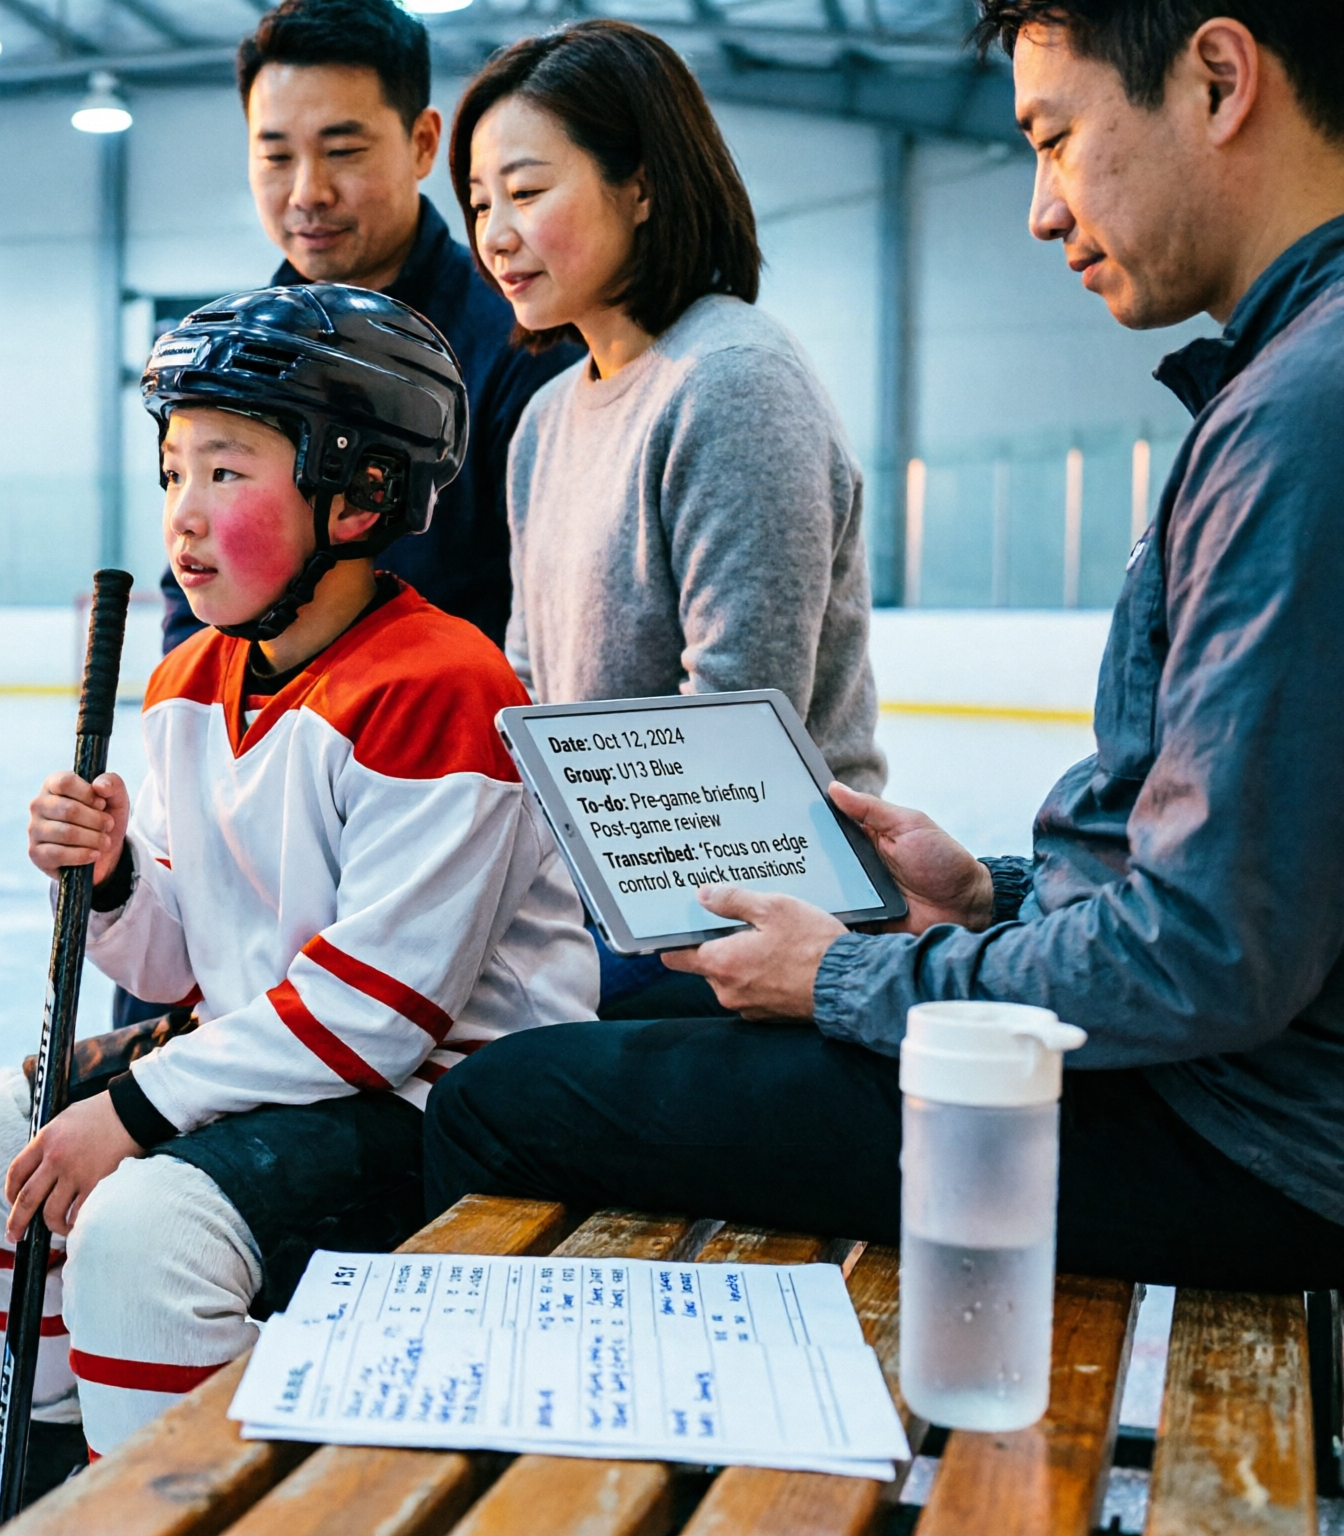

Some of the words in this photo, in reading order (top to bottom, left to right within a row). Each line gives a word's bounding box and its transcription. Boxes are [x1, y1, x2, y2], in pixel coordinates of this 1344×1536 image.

[548, 737, 591, 753] Date:
[593, 734, 621, 750] Oct
[647, 727, 685, 746] 2024
[564, 767, 616, 785] Group:
[616, 761, 648, 779] U13
[649, 759, 684, 776] Blue
[577, 795, 629, 814] To-do:
[630, 792, 701, 811] Pre-game
[701, 783, 759, 803] briefing
[590, 819, 672, 839] Post-game
[674, 812, 721, 831] review
[602, 844, 699, 869] Transcribed:
[751, 841, 770, 853] on
[772, 833, 808, 854] edge
[619, 871, 671, 893] control
[672, 870, 686, 887] &
[687, 865, 729, 888] quick
